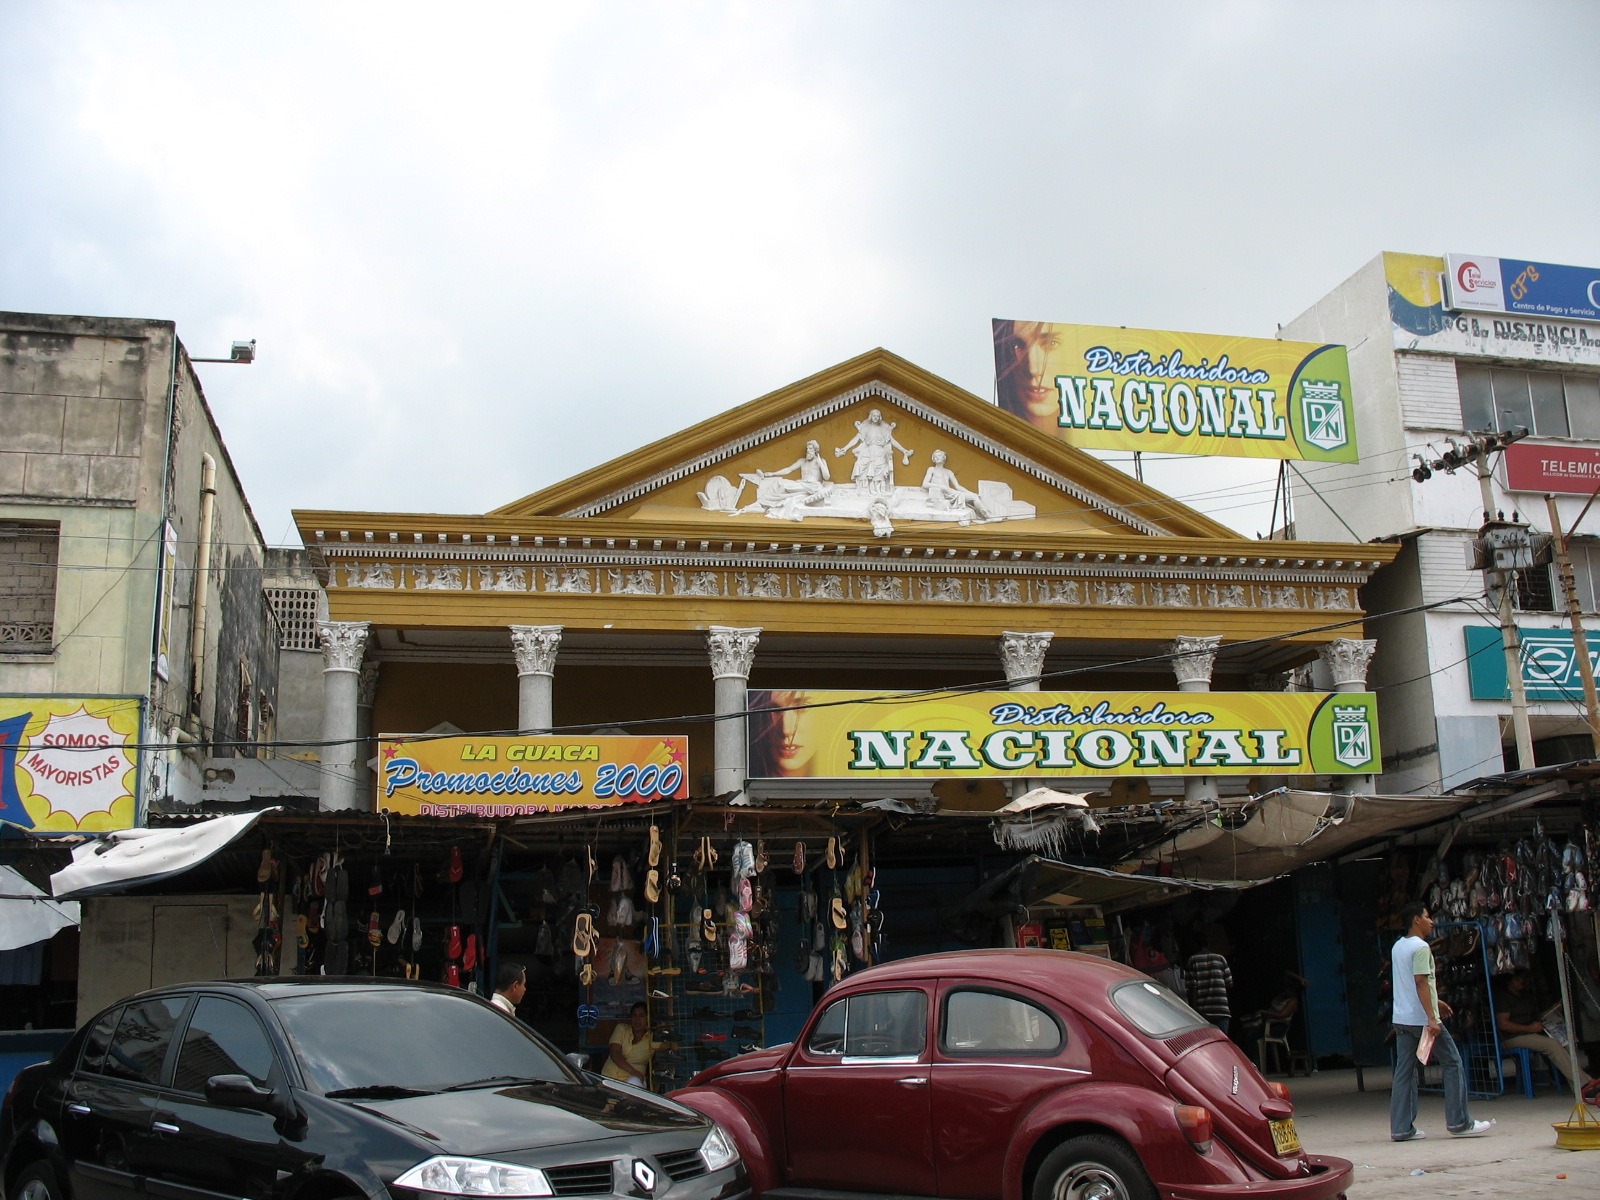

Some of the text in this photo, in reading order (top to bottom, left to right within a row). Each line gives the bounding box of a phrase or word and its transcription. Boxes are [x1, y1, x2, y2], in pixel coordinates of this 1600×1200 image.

[1469, 279, 1497, 288] Servicios
[1512, 301, 1596, 317] Centro de Pago y Servicio
[1493, 319, 1588, 341] DISTANCIA
[1084, 345, 1269, 385] Distribuidora
[1056, 375, 1287, 440] NACIONAL
[989, 701, 1214, 727] Distribuidora
[43, 733, 110, 749] SOMOS
[460, 744, 600, 762] LA GUACA
[847, 729, 1302, 771] NACIONAL
[27, 753, 120, 787] MAYORISTAS
[385, 757, 684, 798] Promociones 2000
